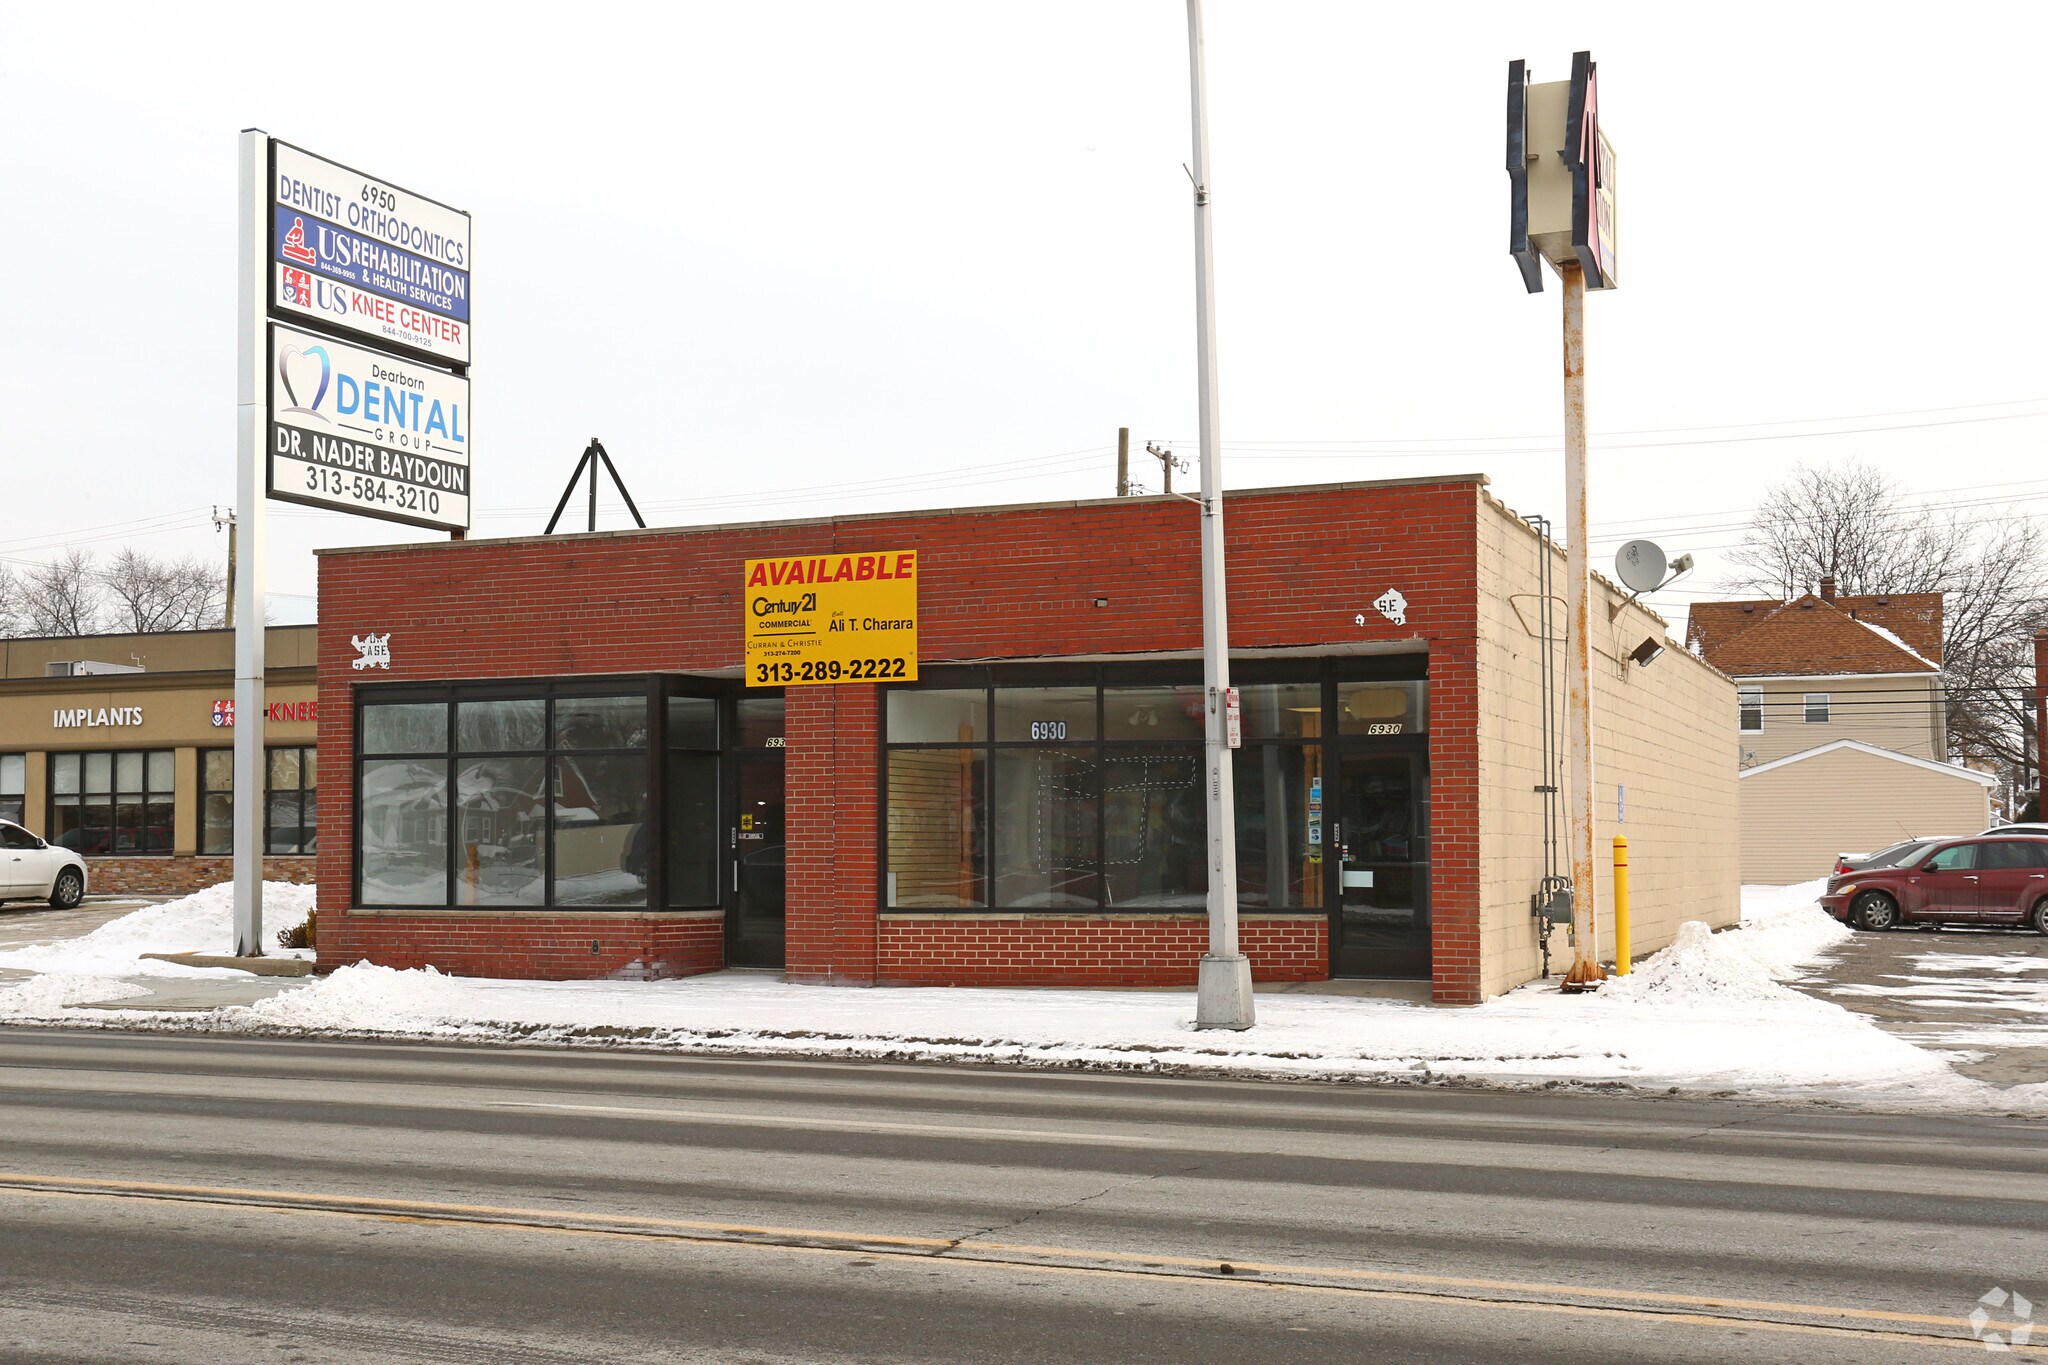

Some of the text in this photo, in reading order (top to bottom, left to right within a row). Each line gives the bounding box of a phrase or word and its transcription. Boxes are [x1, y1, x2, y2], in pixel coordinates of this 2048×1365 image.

[361, 184, 396, 212] 6950
[280, 175, 464, 266] DENTIST ORTHODONTICS
[317, 225, 465, 300] US REHABILITATION
[362, 268, 452, 311] & HEALTH SERVICES
[315, 278, 461, 345] US KNEE CENTER
[382, 325, 433, 348] 844-700-9125
[372, 364, 425, 391] Dearborn
[336, 373, 465, 443] DENTAL
[374, 428, 431, 452] GROUP
[277, 426, 465, 492] DR. NADER BAYDOUN
[306, 465, 440, 515] 313-584-3210
[747, 554, 915, 587] AVAILABLE
[752, 593, 817, 617] Century 21
[759, 620, 811, 629] COMMERCIAL
[829, 618, 913, 632] Ali T. Charara
[757, 658, 905, 683] 313-289-2222
[53, 706, 143, 728] IMPLANTS
[269, 702, 318, 721] KNEE
[1031, 721, 1066, 740] 6930
[1370, 724, 1400, 734] 6930
[767, 738, 785, 747] 693
